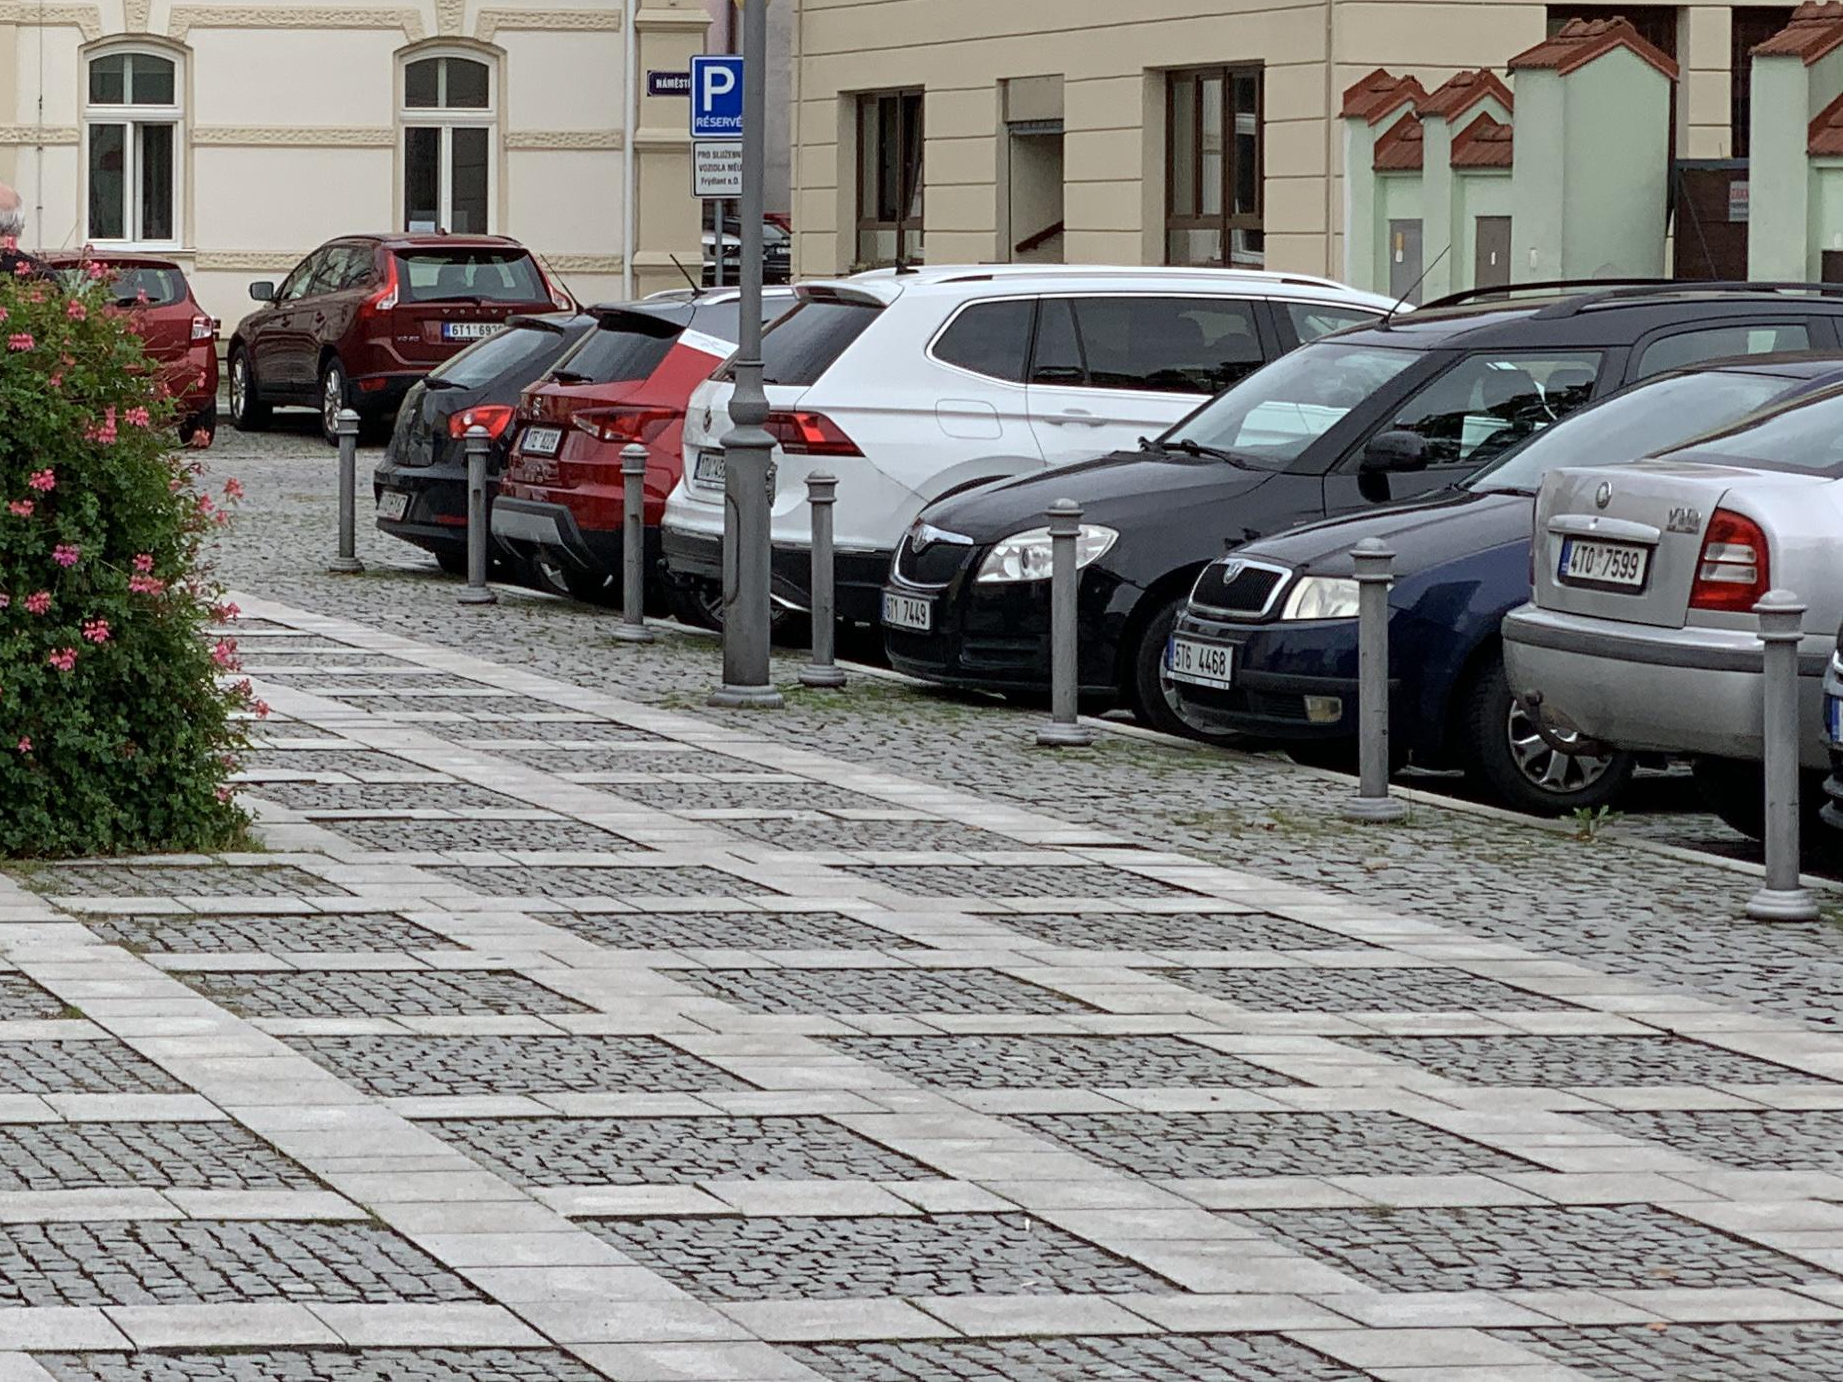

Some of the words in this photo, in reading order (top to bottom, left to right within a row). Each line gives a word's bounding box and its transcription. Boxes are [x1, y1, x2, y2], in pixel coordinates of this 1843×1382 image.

[703, 66, 736, 111] P
[696, 115, 743, 128] RÉSERVÉ
[712, 149, 742, 159] SLUŽEBN
[451, 325, 471, 336] 6T1
[1602, 549, 1639, 580] 7599
[903, 600, 926, 626] 7449
[1198, 647, 1226, 676] 4468
